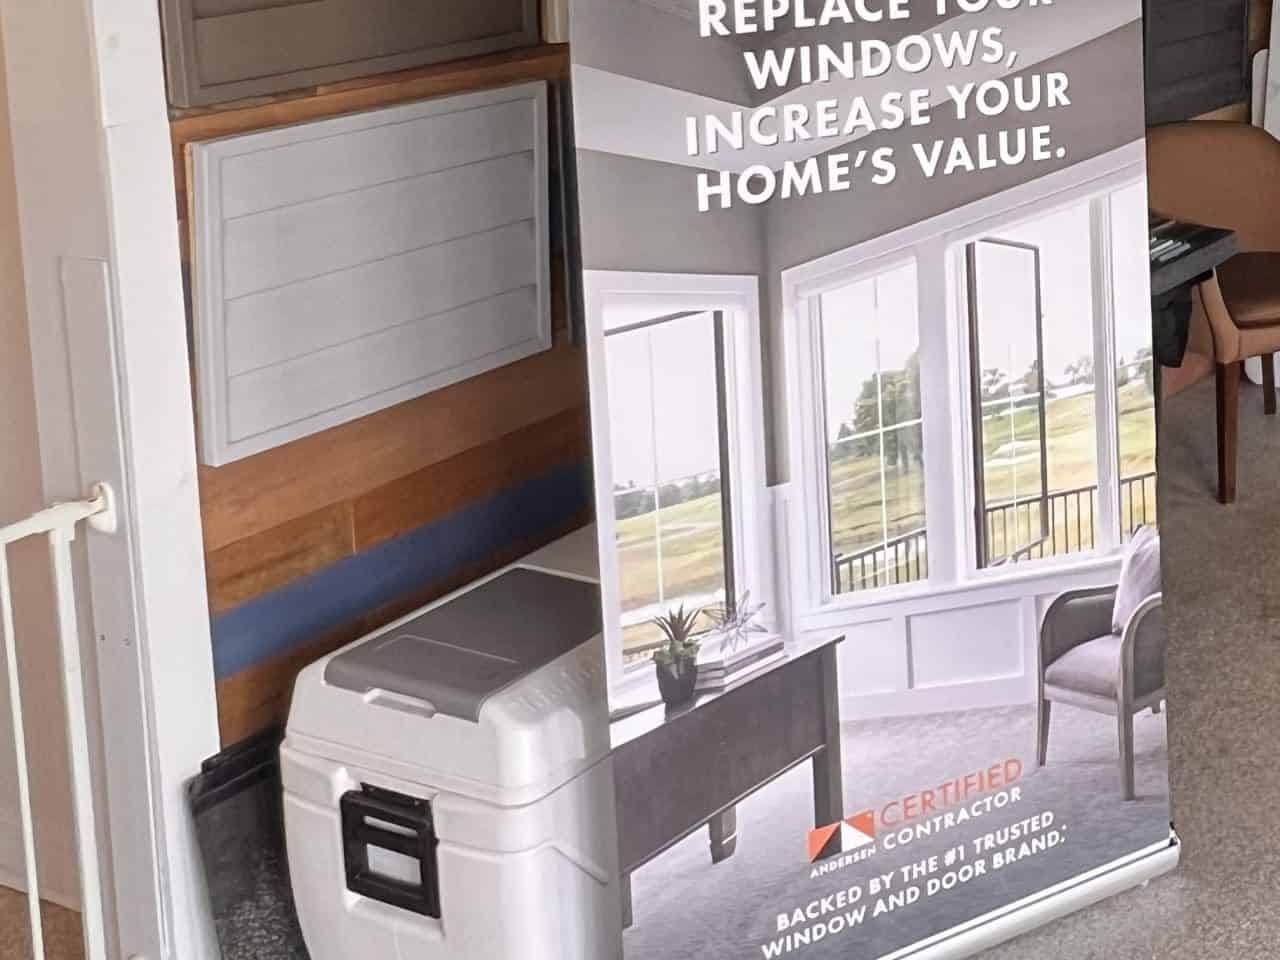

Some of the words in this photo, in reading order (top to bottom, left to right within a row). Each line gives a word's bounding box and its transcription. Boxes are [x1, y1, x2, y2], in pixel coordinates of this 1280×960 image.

[743, 26, 1018, 90] WINDOWS,
[685, 88, 932, 156] INCREASE
[946, 72, 1072, 120] YOUR
[912, 125, 1067, 178] VALUE.
[810, 844, 877, 880] ANDERSEN
[882, 786, 1022, 852] CONTRACTOR
[880, 758, 1024, 828] CERTIFIED
[761, 905, 868, 960] WINDOW
[872, 886, 921, 918] AND
[926, 862, 988, 898] DOOR
[777, 887, 863, 932] BACKED
[868, 871, 895, 896] BY
[901, 854, 939, 883] THE
[943, 844, 966, 868] #1
[973, 811, 1055, 854] TRUSTED
